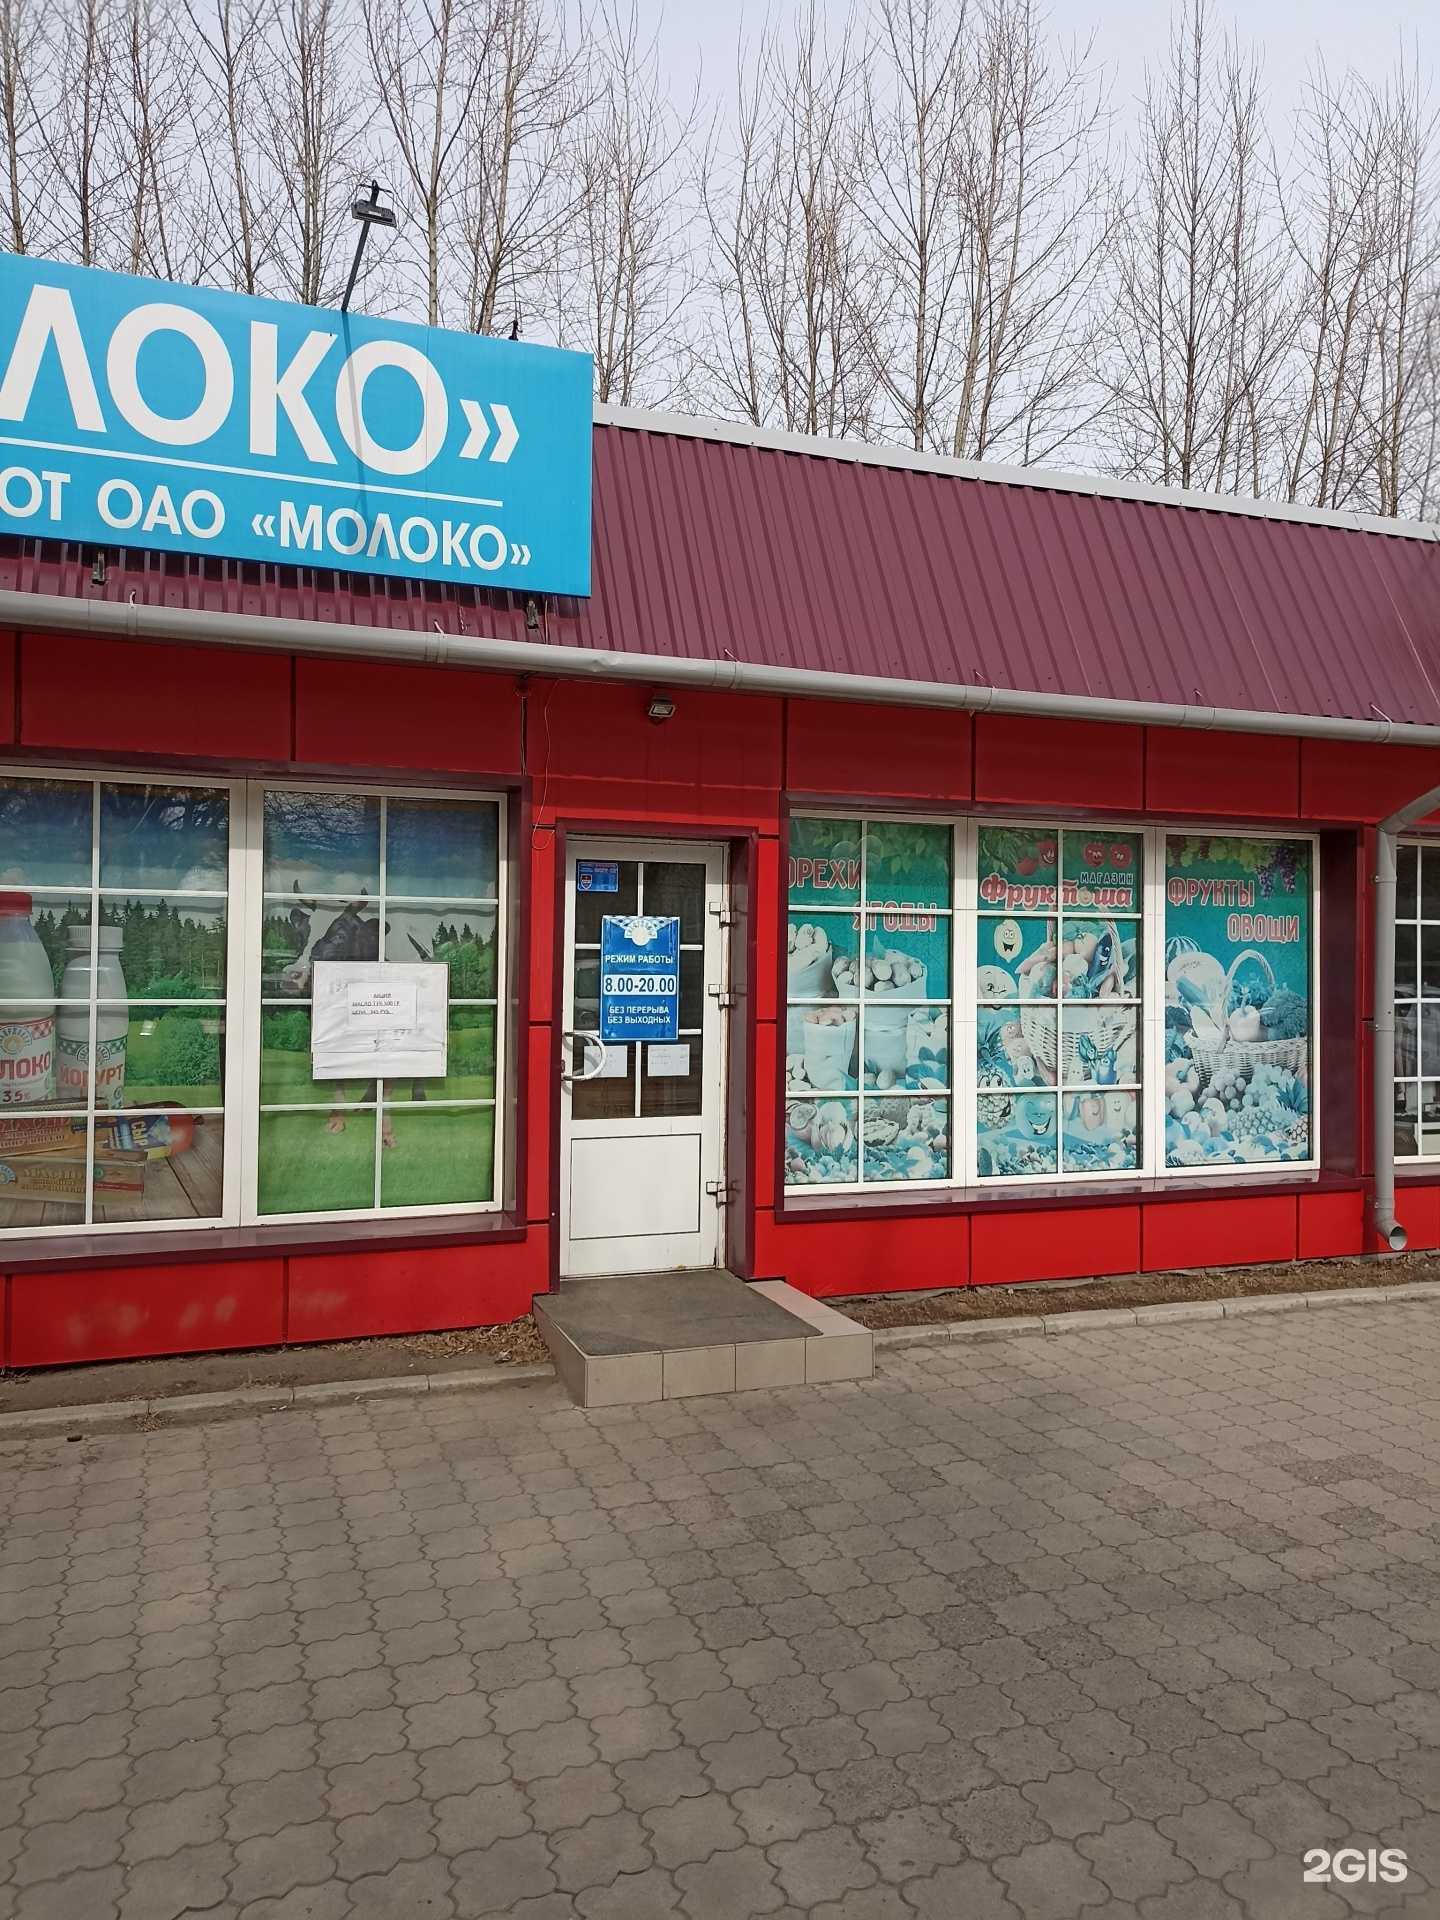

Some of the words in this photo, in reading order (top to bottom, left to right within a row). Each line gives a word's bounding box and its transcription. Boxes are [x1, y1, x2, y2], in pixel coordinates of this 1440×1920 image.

[0, 466, 71, 521] ОТ
[97, 478, 226, 539] ОАО
[251, 501, 532, 572] «МОЛОКО»
[1080, 871, 1134, 885] МАГАЗИН
[1167, 877, 1255, 907] ФРУКТЫ
[852, 900, 937, 933] ЯГОДЫ
[1227, 913, 1299, 943] ОВОЩИ
[605, 954, 636, 964] РЕЖИМ
[637, 954, 673, 964] РАБОТЫ
[605, 977, 675, 993] 8.00-20.00
[609, 1006, 625, 1015] БЕЗ
[626, 1006, 669, 1015] ПЕРЕРЫВА
[607, 1015, 624, 1025] БЕЗ
[625, 1015, 671, 1025] ВЫХОДНЫХ
